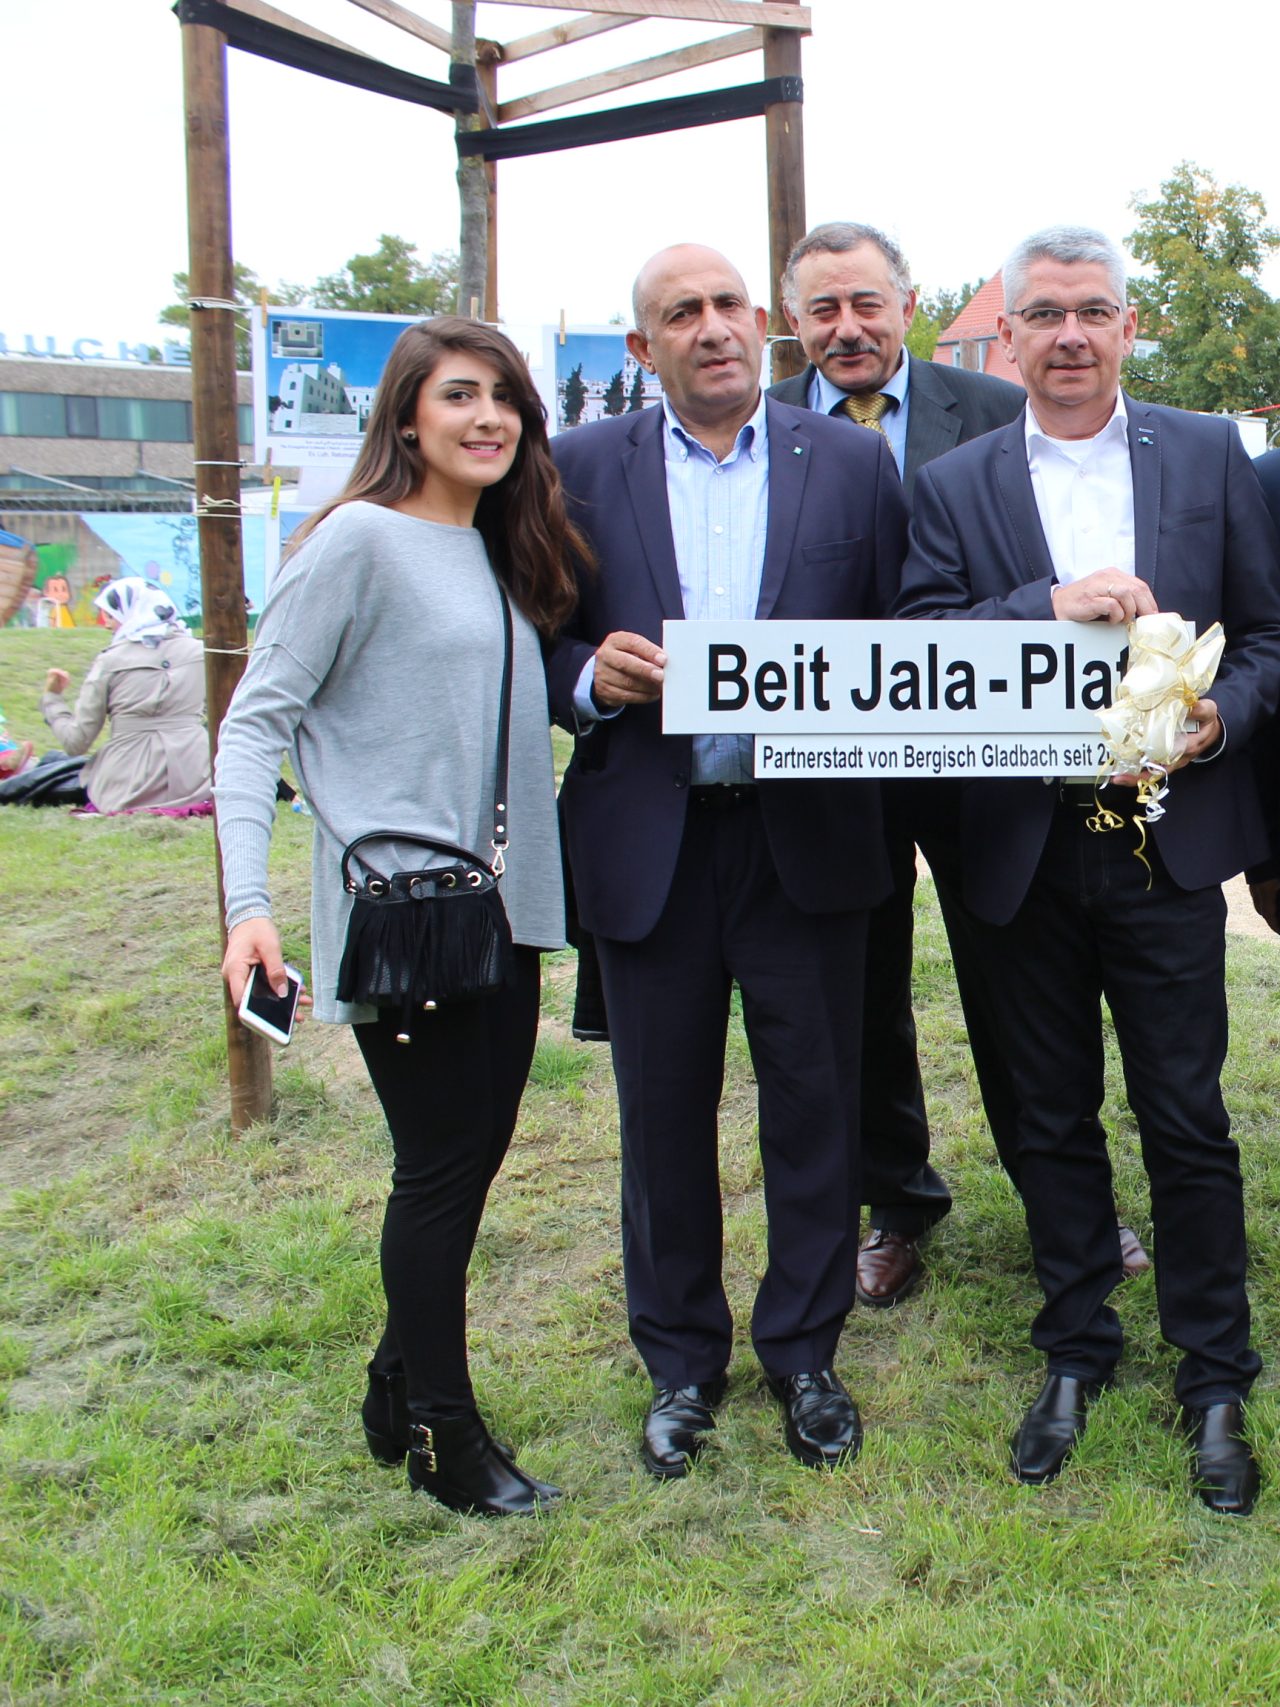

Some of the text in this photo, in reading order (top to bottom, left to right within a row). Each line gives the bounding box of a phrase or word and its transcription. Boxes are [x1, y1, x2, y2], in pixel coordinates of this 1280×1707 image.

[708, 643, 830, 712] Beit
[763, 745, 863, 769] Partnerstadt
[868, 750, 898, 768] von
[904, 744, 976, 774] Bergisch
[982, 744, 1058, 768] Gladbach
[1063, 743, 1093, 767] seit
